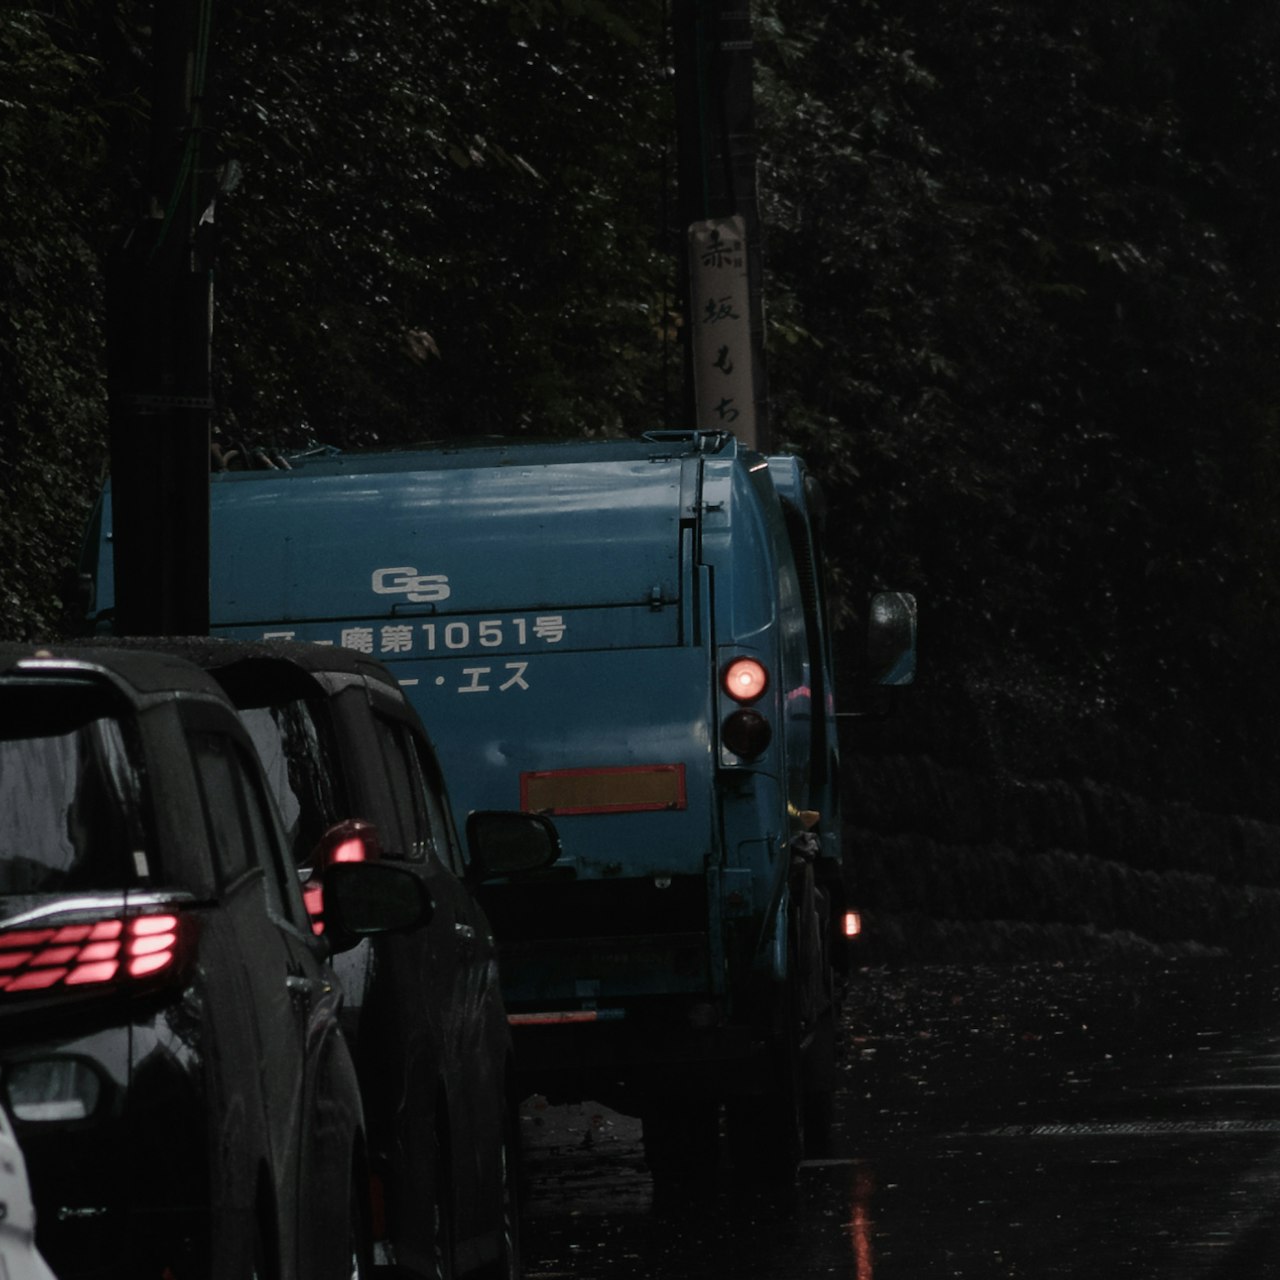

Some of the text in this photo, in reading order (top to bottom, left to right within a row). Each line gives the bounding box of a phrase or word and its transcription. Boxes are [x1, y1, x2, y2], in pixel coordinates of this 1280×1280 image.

[371, 566, 451, 603] GS
[263, 615, 567, 655] 一廃第1051号
